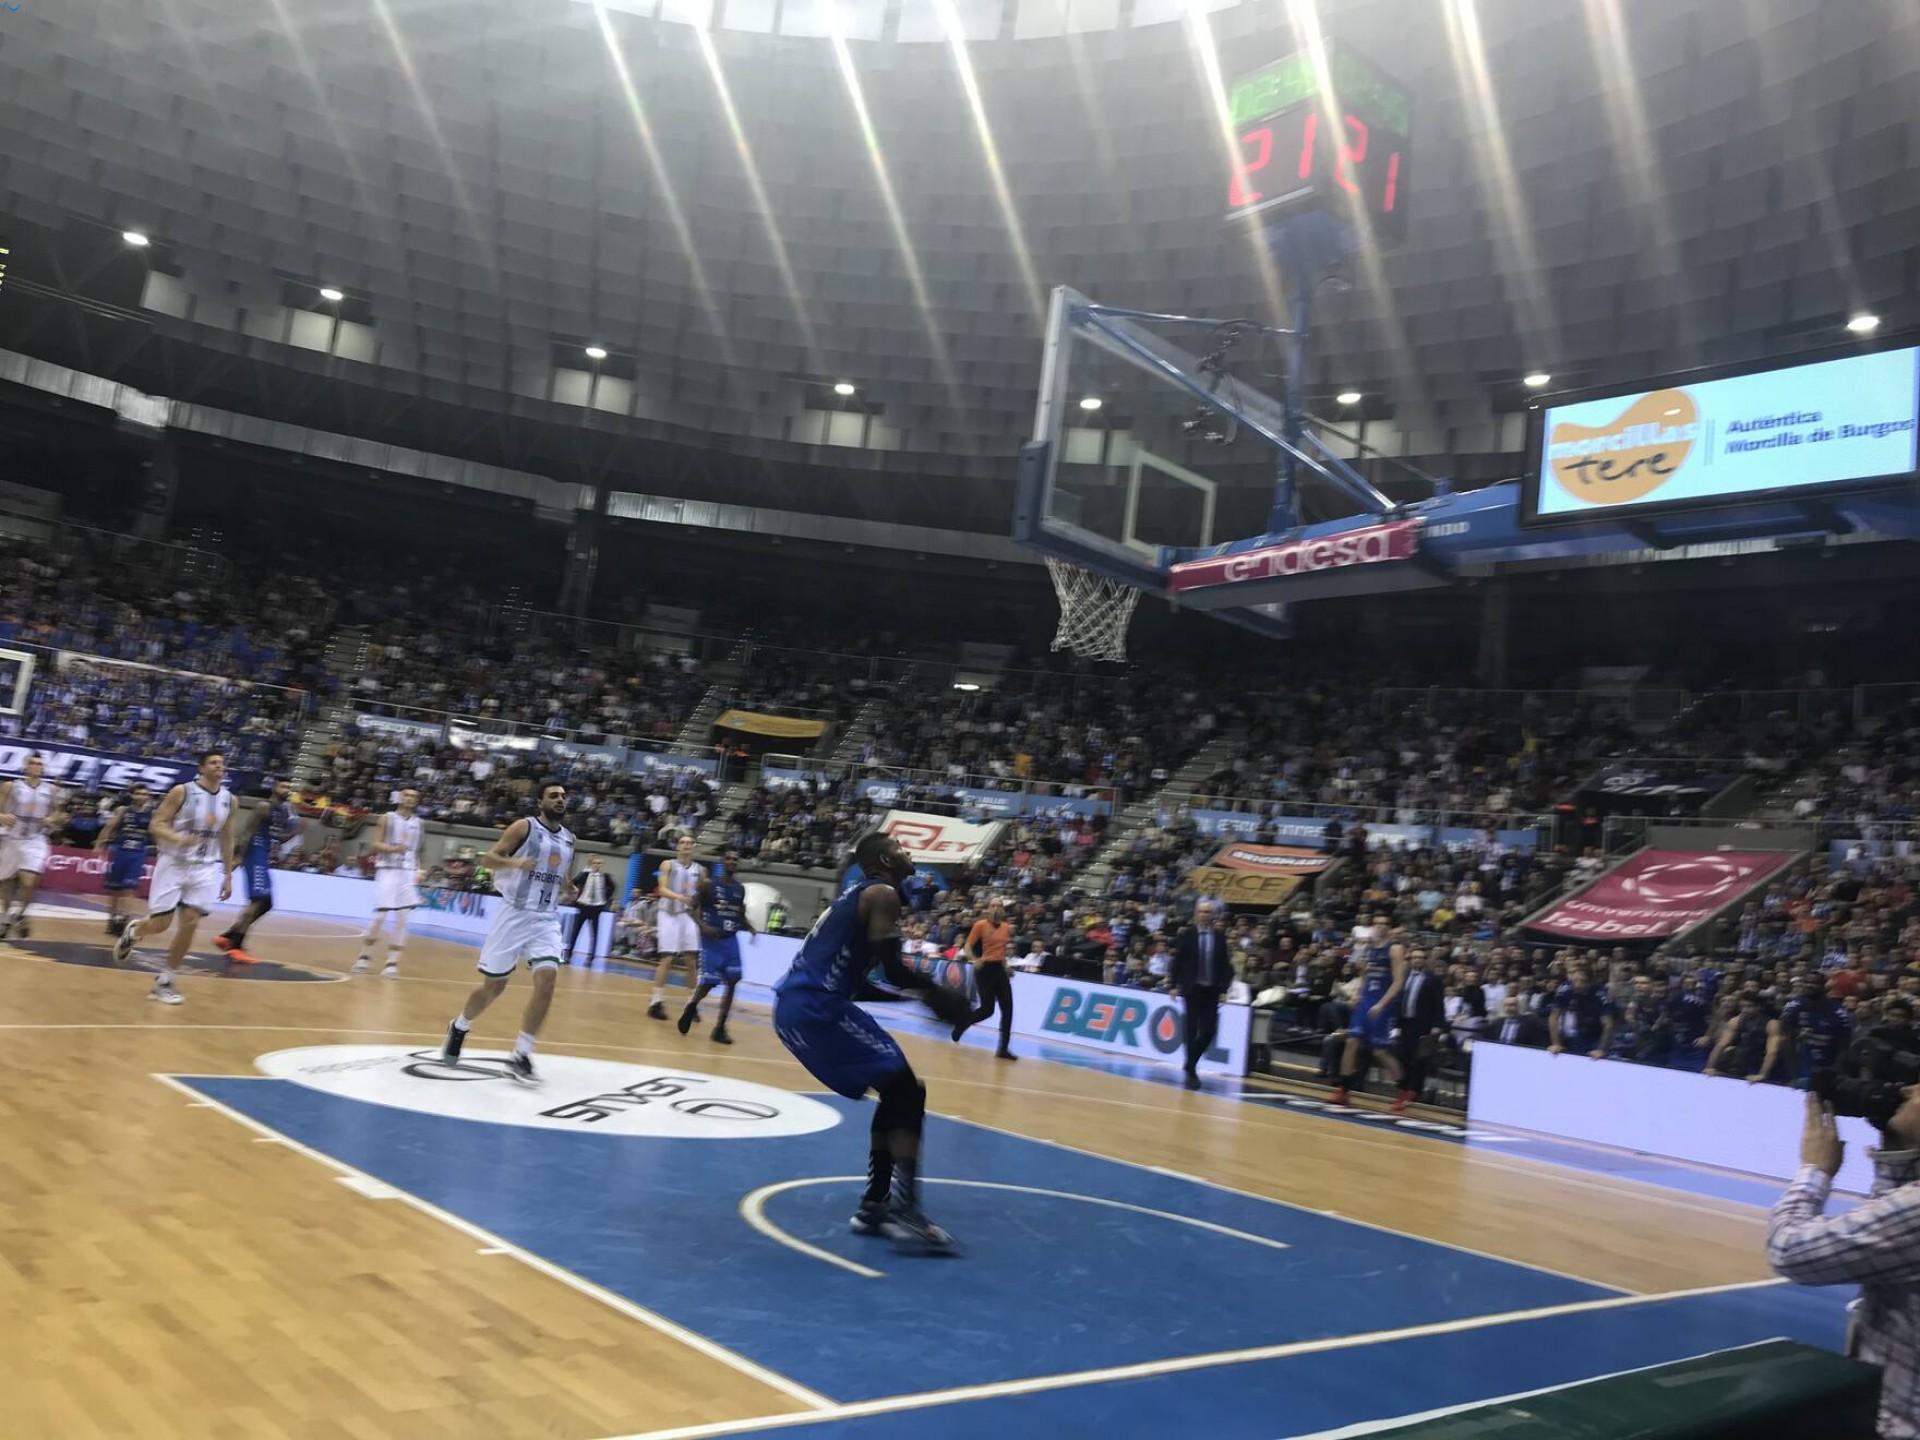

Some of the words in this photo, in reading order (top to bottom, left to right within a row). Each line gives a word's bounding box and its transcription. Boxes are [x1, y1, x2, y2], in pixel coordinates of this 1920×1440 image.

[1806, 428, 1836, 444] de
[1562, 452, 1676, 484] tere
[1223, 530, 1392, 582] endesa
[539, 889, 552, 904] 14
[1541, 911, 1669, 934] Isabel
